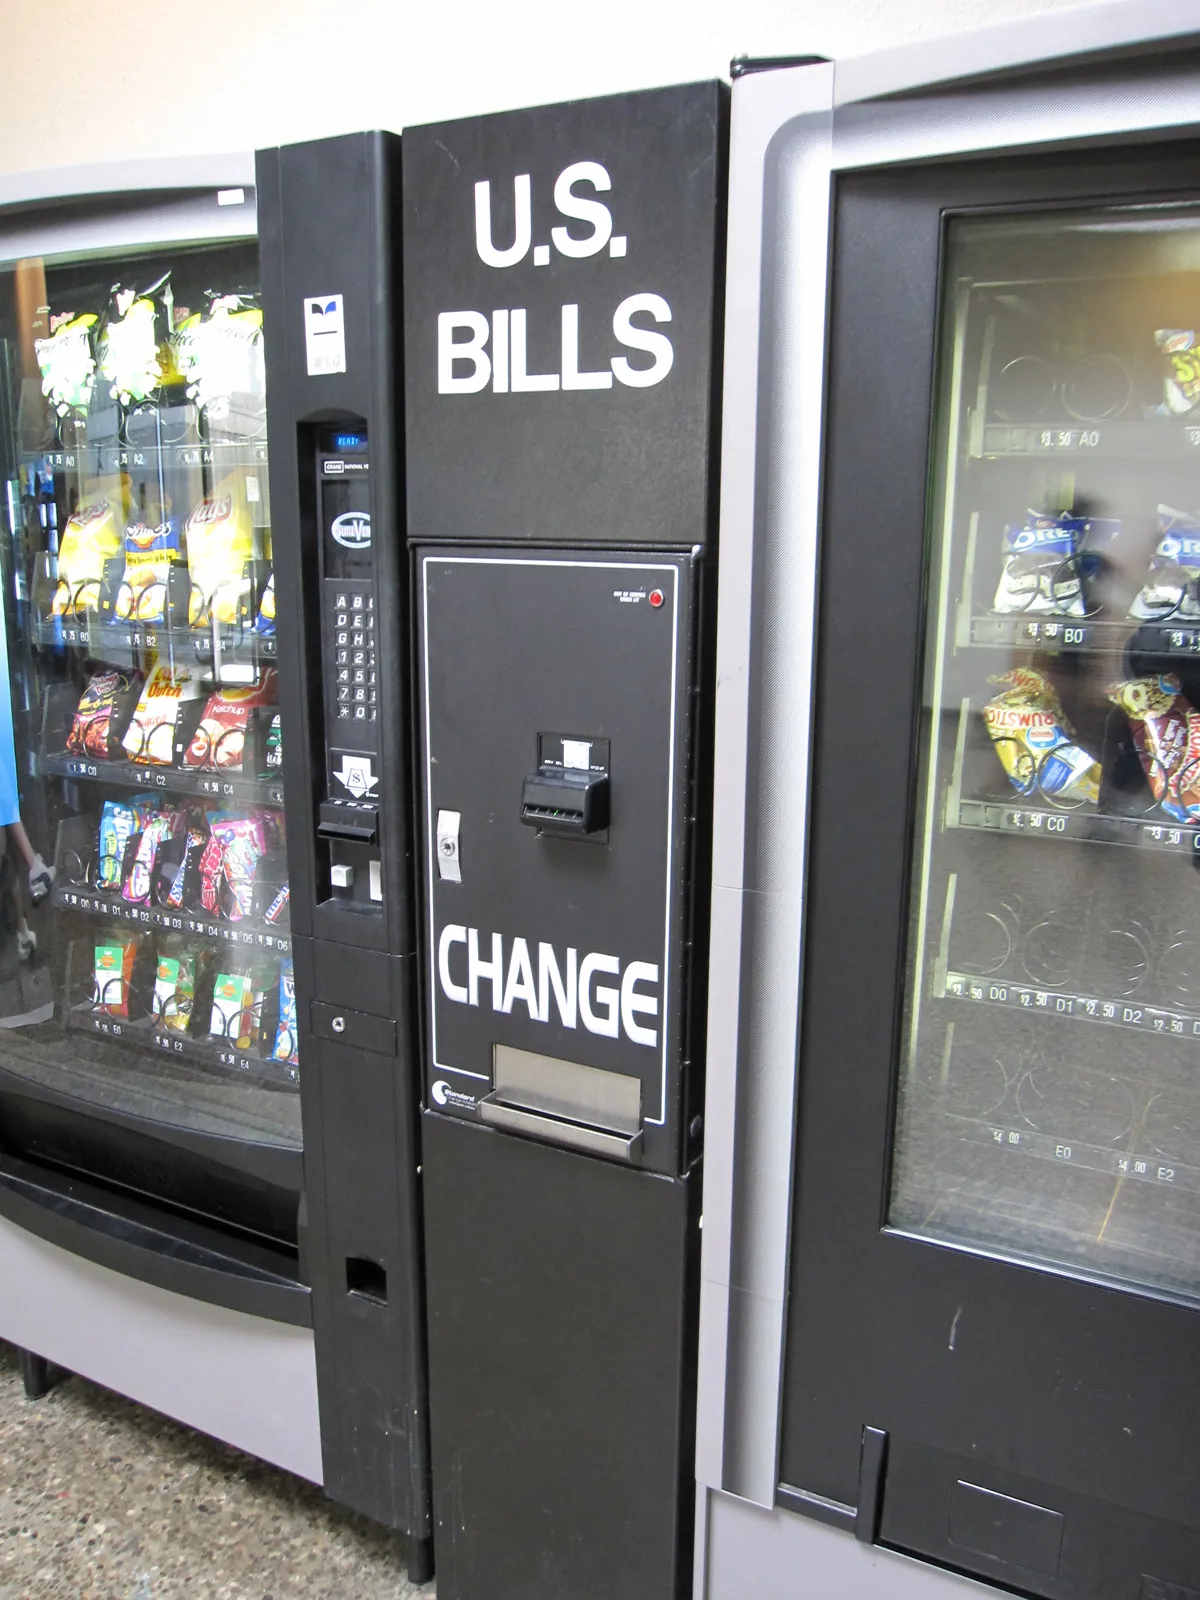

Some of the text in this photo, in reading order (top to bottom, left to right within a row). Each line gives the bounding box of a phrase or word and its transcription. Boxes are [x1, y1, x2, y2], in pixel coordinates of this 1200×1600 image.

[475, 161, 627, 268] U.S.
[438, 293, 674, 394] BILLS
[1079, 431, 1100, 447] A0
[66, 456, 75, 467] A0
[134, 453, 144, 465] A2
[204, 450, 214, 462] A4
[1156, 538, 1200, 557] OR
[337, 596, 362, 607] A B
[338, 614, 362, 626] D E
[146, 635, 157, 647] B2
[338, 633, 363, 646] G H
[1064, 628, 1084, 643] B0
[341, 651, 363, 663] 1 2
[340, 669, 364, 681] 4 5
[148, 681, 182, 698] Dutch
[341, 688, 365, 700] 7 8
[212, 704, 245, 716] Ketchup
[356, 707, 365, 718] 0
[88, 765, 97, 776] C0
[156, 775, 166, 786] C2
[223, 784, 234, 796] C4
[1047, 816, 1066, 832] C0
[1194, 834, 1200, 848] C
[112, 905, 120, 916] D1
[141, 911, 150, 923] D2
[172, 918, 182, 929] D3
[208, 926, 218, 937] D4
[243, 932, 253, 944] D5
[277, 939, 288, 952] D6
[439, 924, 658, 1048] CHANGE
[952, 982, 1200, 1035] $2.50 D0 $2.50 D1 $2.50 D2 $2.50 D
[113, 1024, 121, 1034] E0
[174, 1041, 183, 1052] E2
[240, 1060, 249, 1070] E4
[444, 1089, 475, 1102] Standard
[1056, 1145, 1071, 1159] E0
[1118, 1160, 1174, 1182] $4.00 E2
